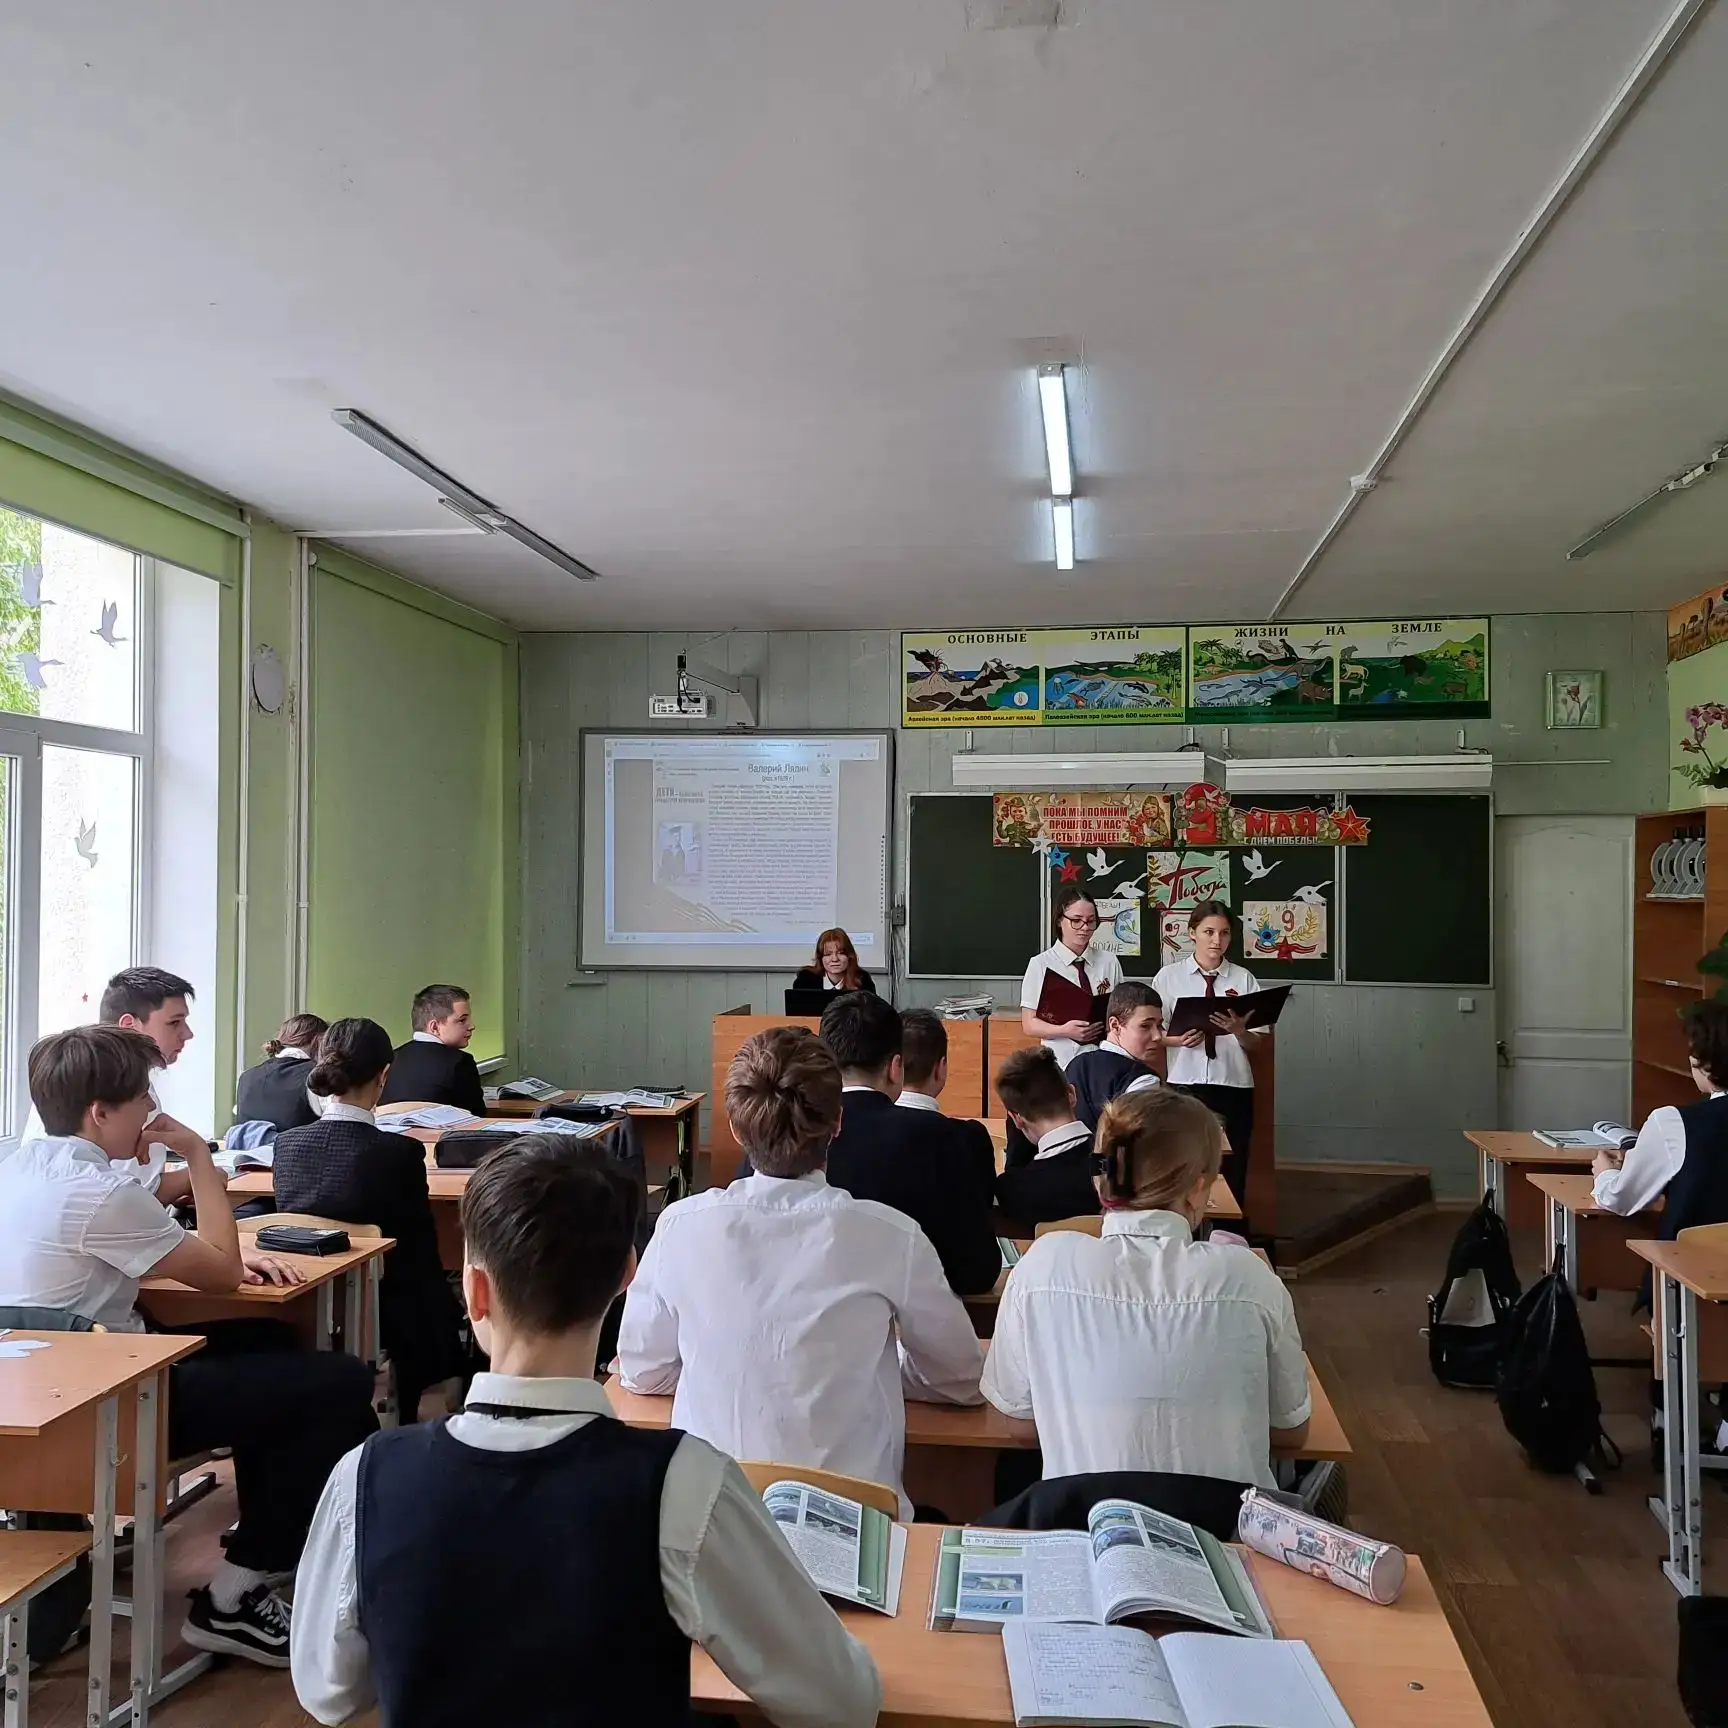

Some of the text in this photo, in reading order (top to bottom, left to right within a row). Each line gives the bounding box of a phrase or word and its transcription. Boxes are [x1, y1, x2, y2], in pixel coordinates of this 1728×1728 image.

[947, 622, 1442, 644] ОСНОВНЫЕ ЭТАПЫ ЖИЗНИ НА ЗЕМЛЕ
[748, 763, 782, 775] Валерий
[1043, 807, 1128, 817] ПОКА МЫ ПОМНИМ
[1096, 819, 1102, 830] У
[1103, 819, 1122, 830] НАС
[1244, 812, 1318, 837] МАЯ
[1051, 832, 1120, 844] ЕСТЬ БУДУЩЕЕ!
[1243, 837, 1249, 845] С
[1250, 836, 1275, 846] ДНЕМ
[1282, 909, 1295, 932] 9
[1168, 923, 1180, 938] 9
